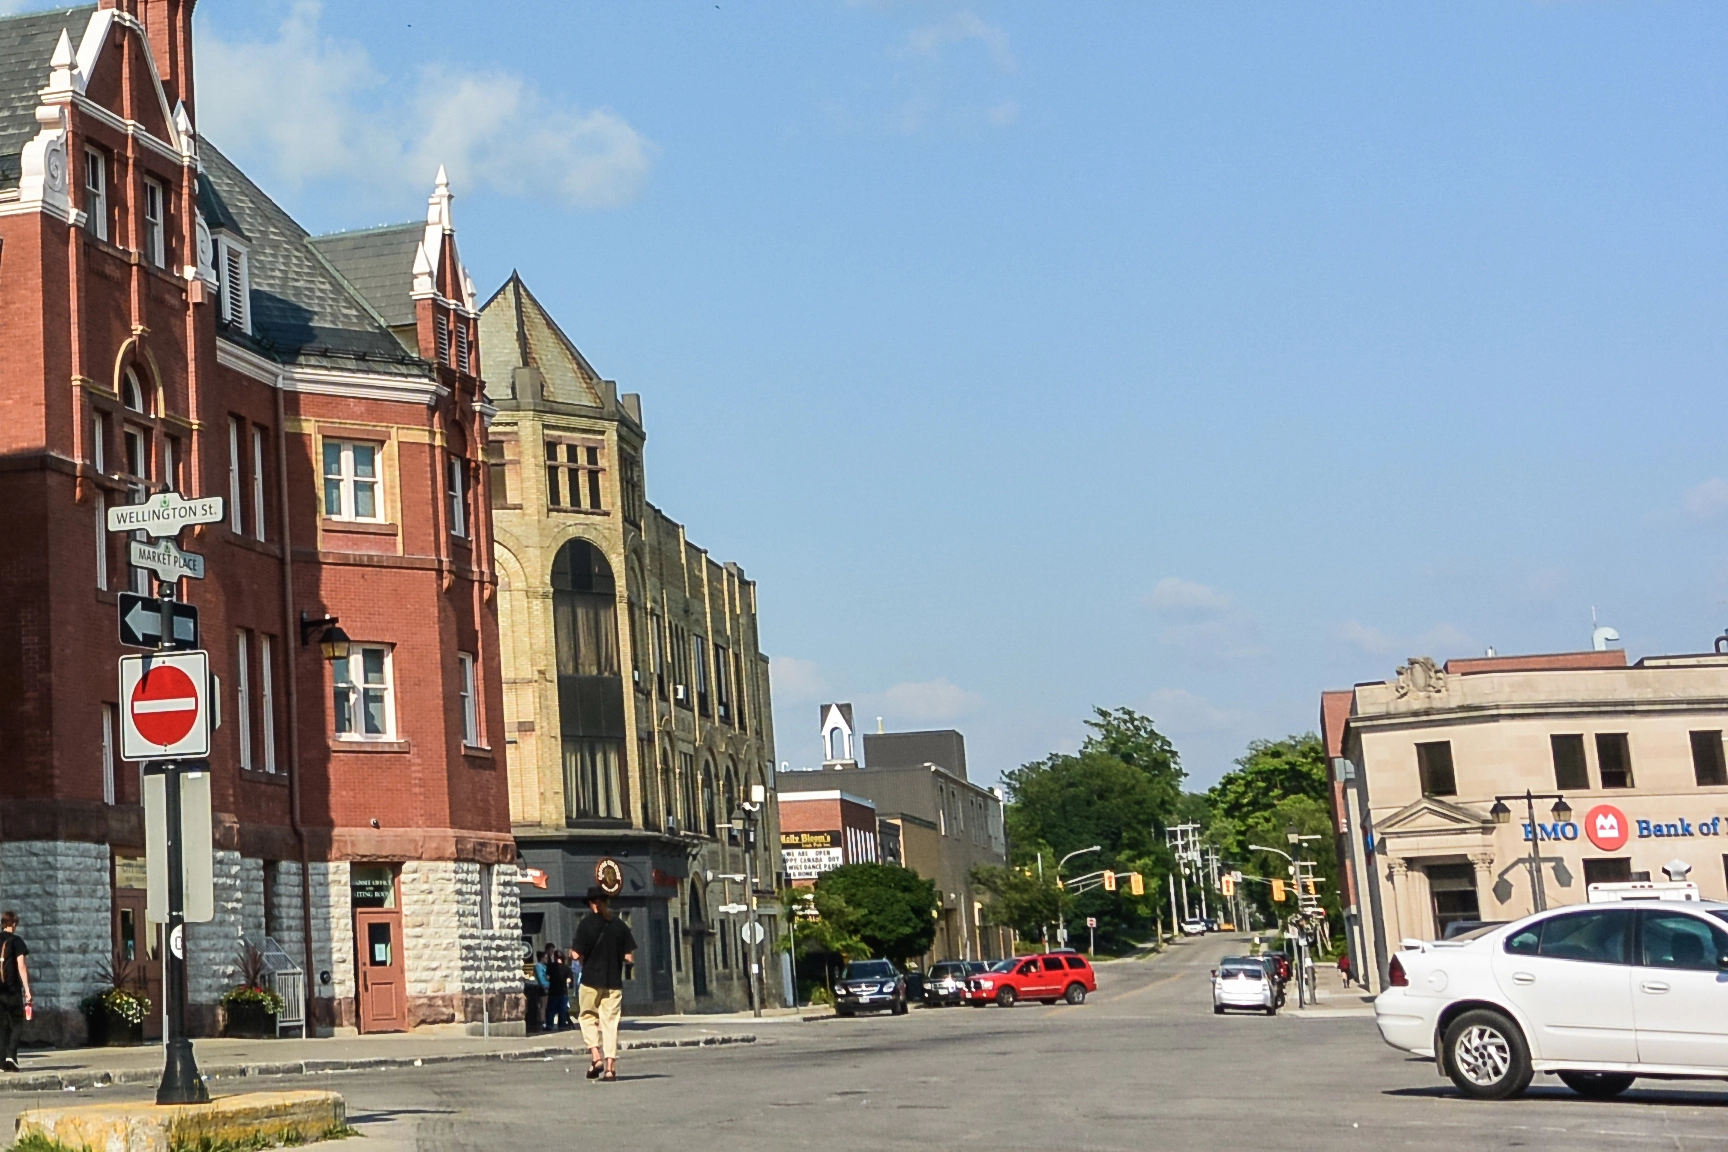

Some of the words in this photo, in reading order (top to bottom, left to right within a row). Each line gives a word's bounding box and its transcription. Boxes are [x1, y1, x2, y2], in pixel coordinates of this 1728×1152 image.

[116, 505, 197, 525] WELLINGTON
[201, 503, 217, 516] St.
[138, 548, 172, 565] MARKET
[173, 555, 197, 572] PLACE
[1636, 818, 1694, 839] Bank
[1698, 816, 1721, 837] of
